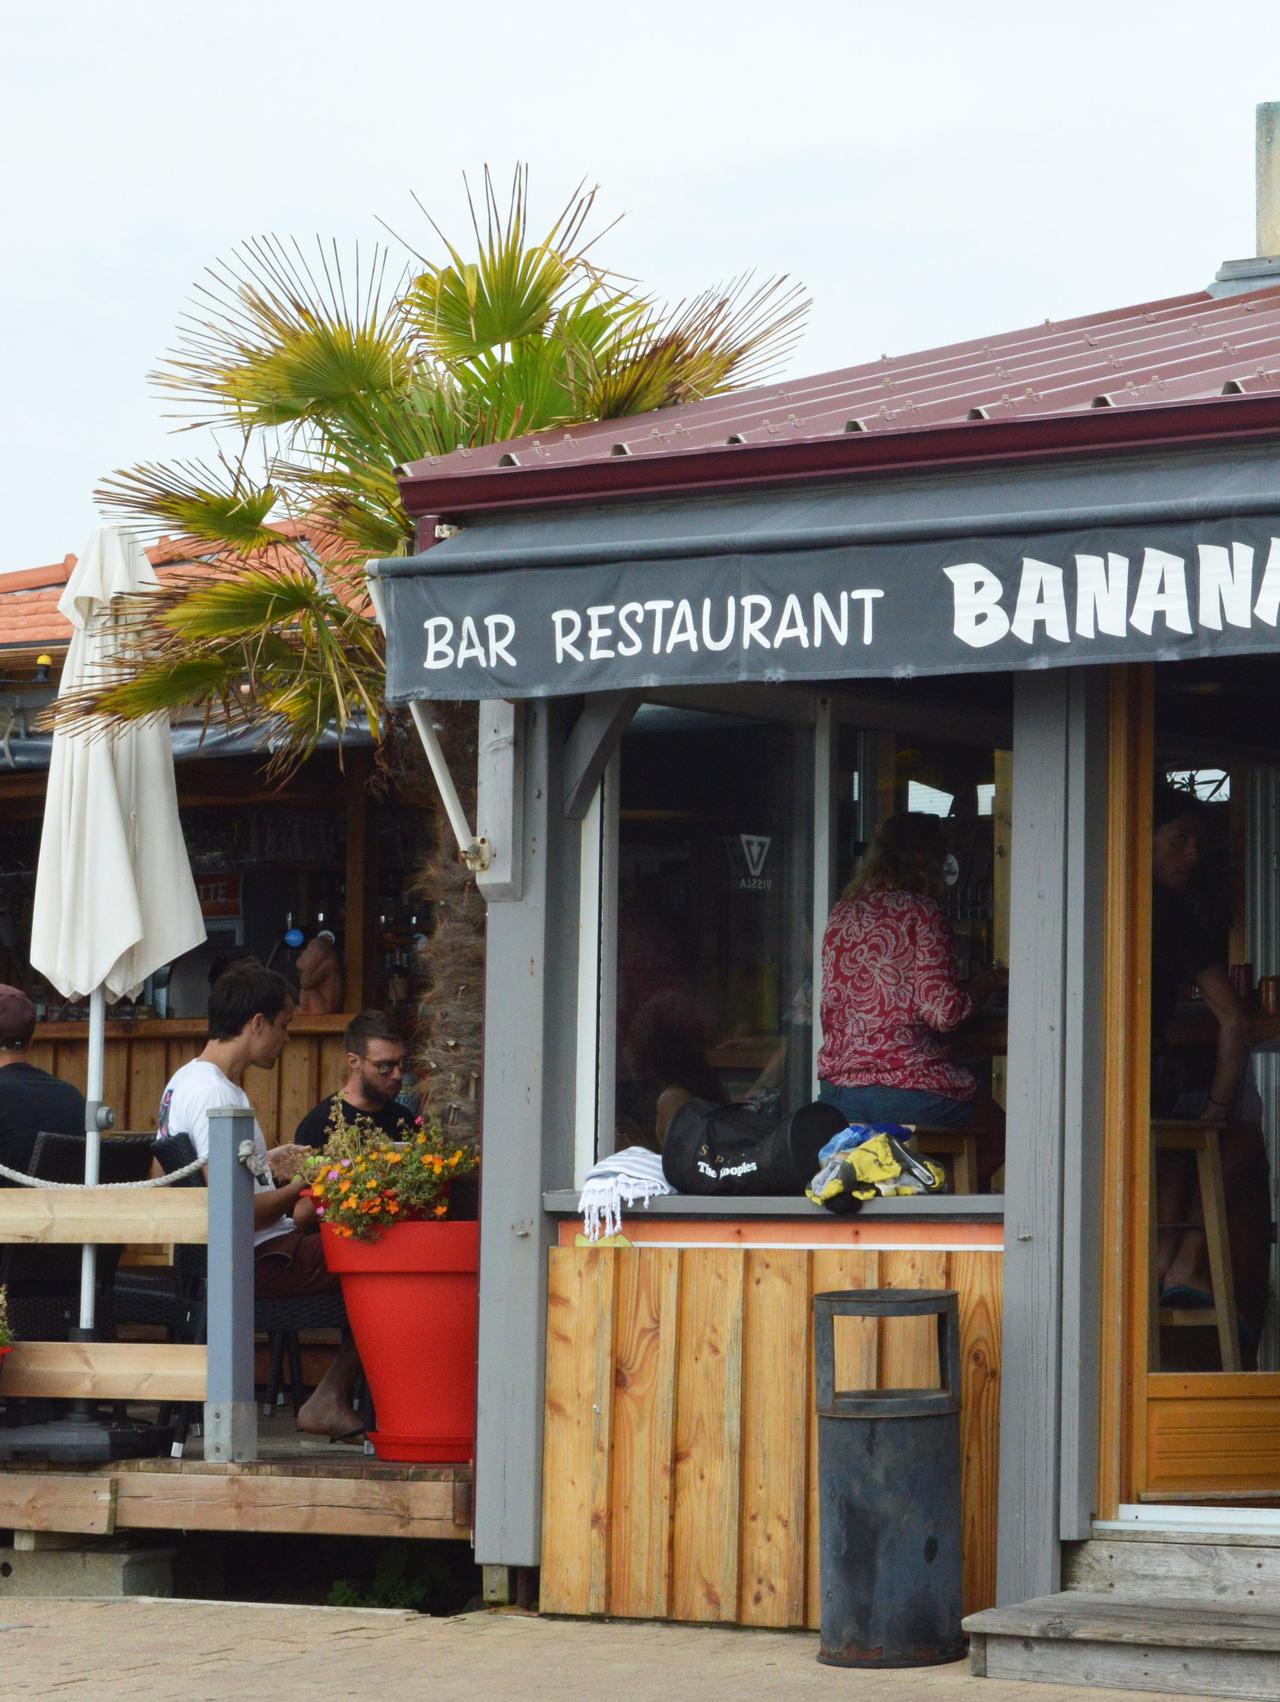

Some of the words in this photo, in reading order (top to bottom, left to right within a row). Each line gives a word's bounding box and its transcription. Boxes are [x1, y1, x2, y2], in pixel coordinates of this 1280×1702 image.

[424, 614, 516, 669] BAR
[552, 589, 884, 663] RESTAURANT
[698, 1161, 717, 1178] The
